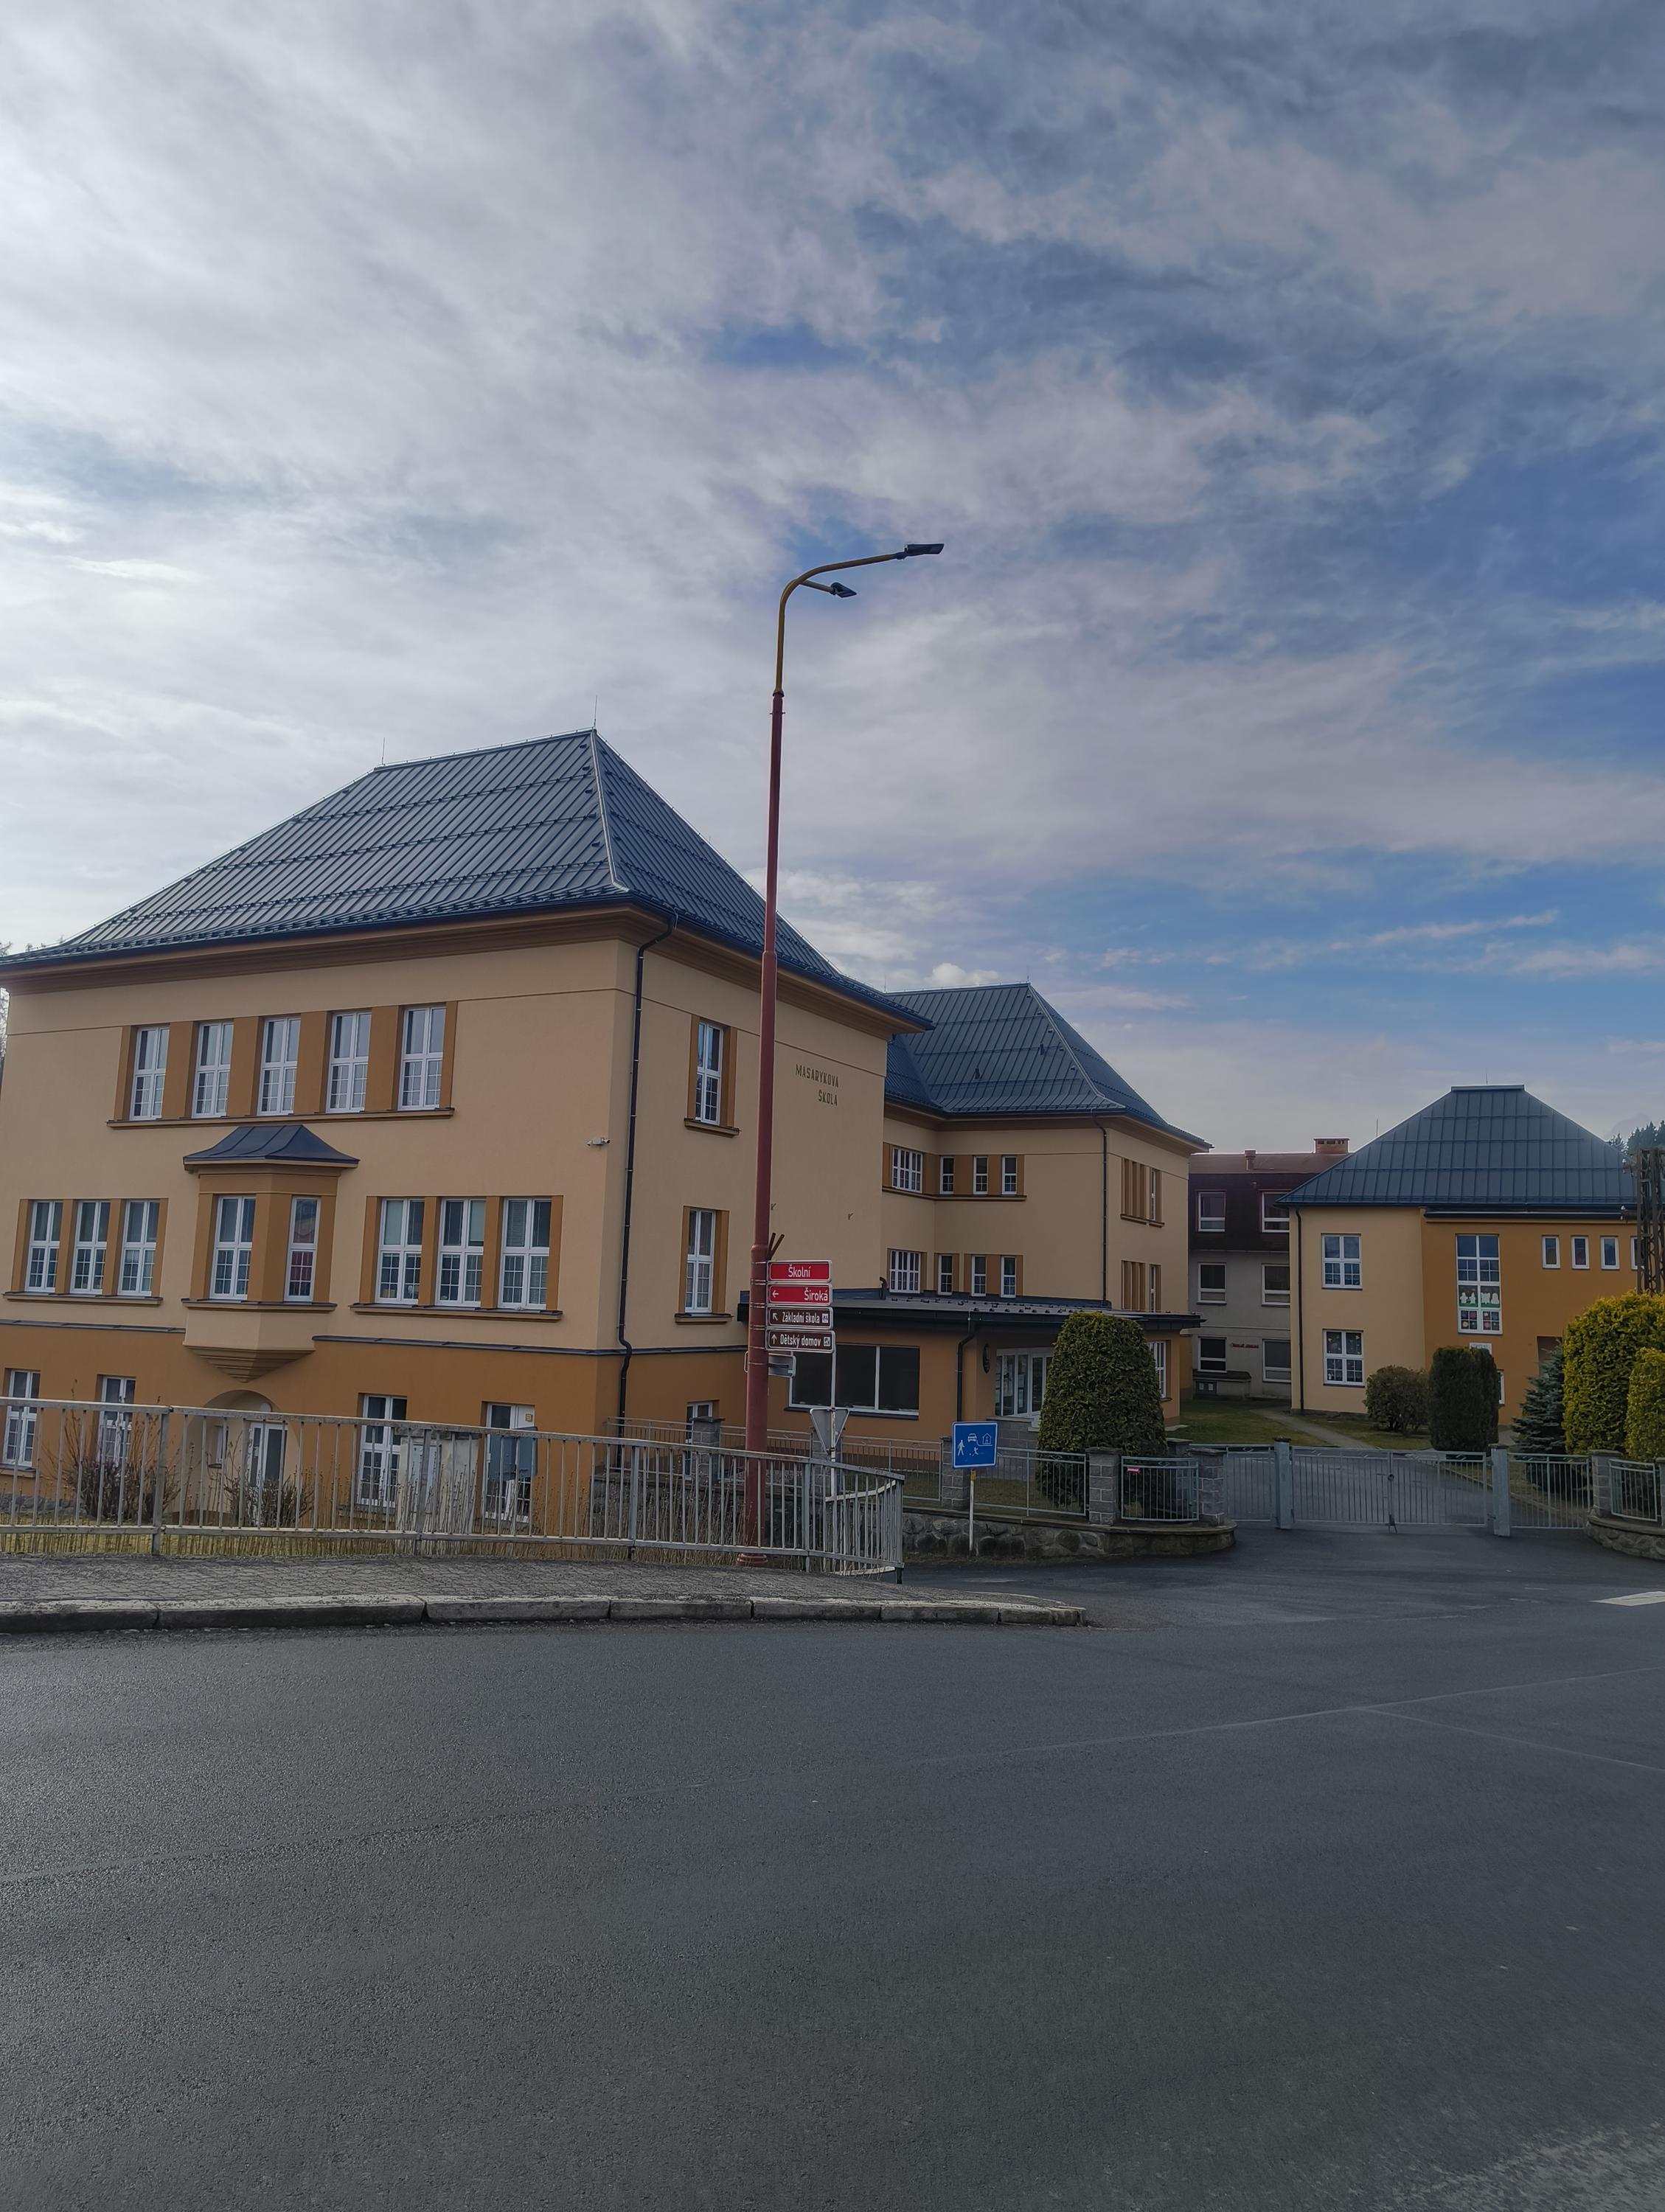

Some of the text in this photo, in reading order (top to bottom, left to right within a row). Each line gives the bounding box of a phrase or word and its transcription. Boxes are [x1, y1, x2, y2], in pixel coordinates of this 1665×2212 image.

[796, 1064, 838, 1088] MASARYKOVA
[788, 1264, 811, 1277] Školní
[804, 1287, 828, 1301] Široká
[782, 1311, 820, 1324] Základní škola
[780, 1334, 821, 1349] Dětský domov
